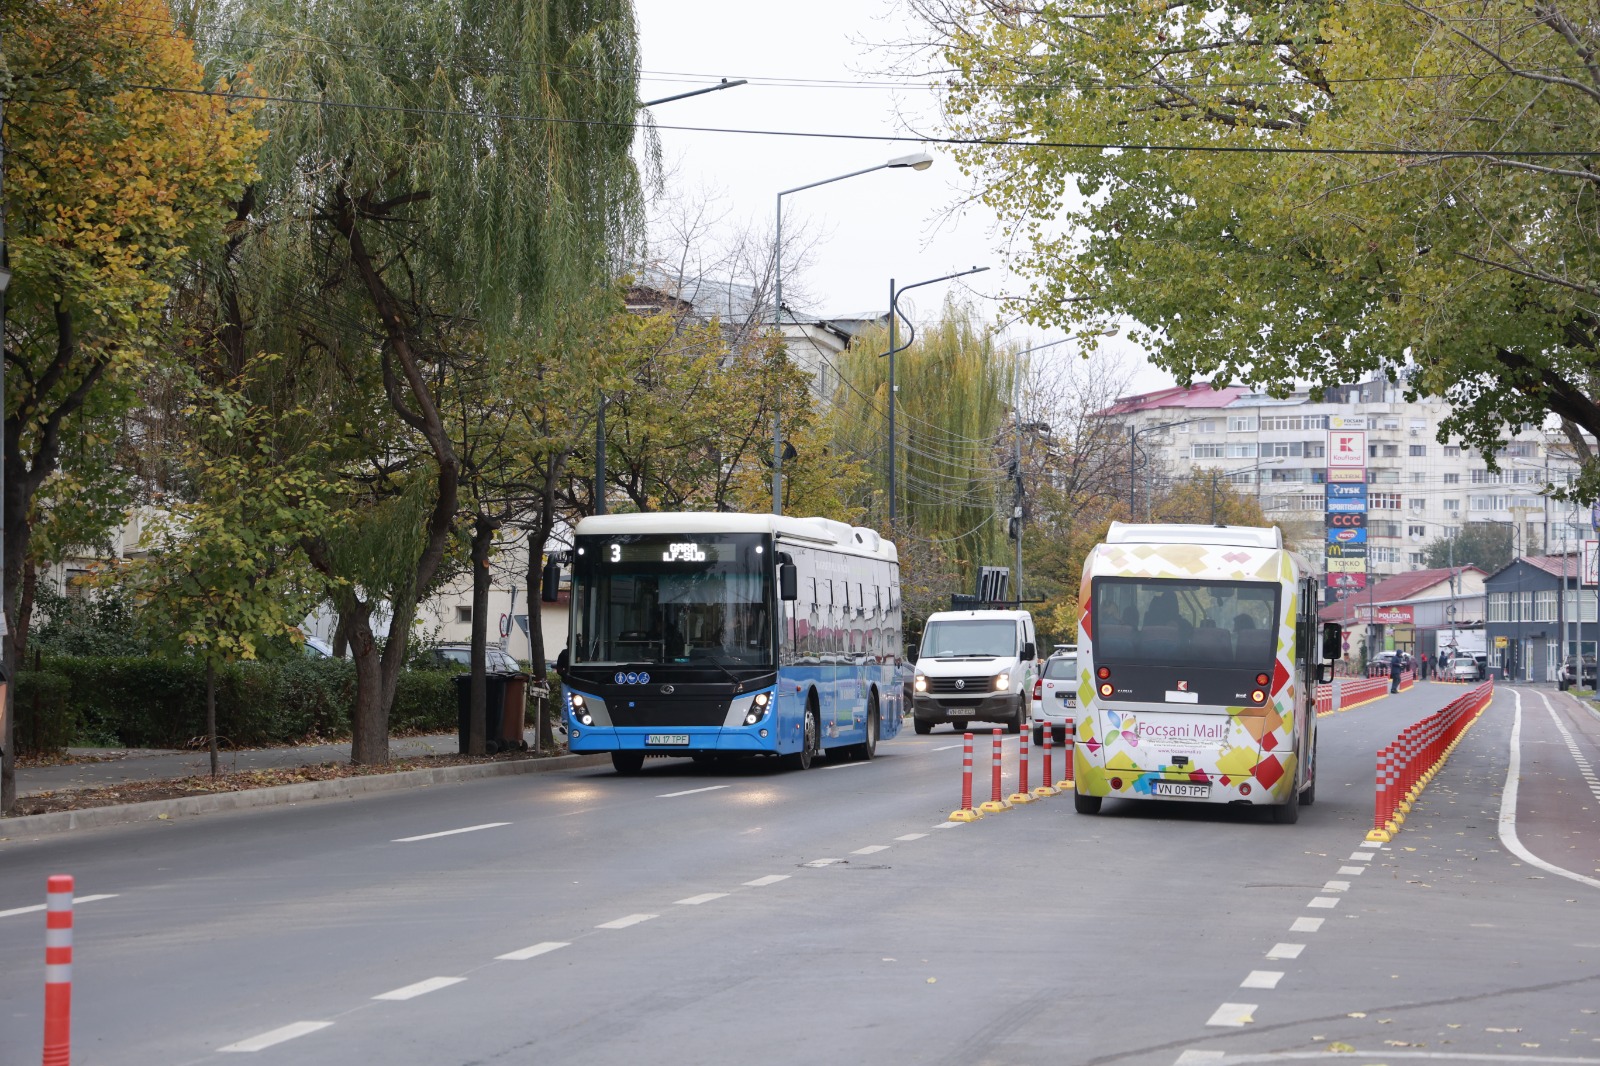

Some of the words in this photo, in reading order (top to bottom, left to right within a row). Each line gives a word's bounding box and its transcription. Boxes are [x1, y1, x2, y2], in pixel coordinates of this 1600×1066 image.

[1333, 515, 1360, 526] CCC
[611, 544, 621, 562] 3
[669, 543, 698, 553] GARA
[1193, 724, 1223, 738] Mall
[650, 735, 660, 743] VN
[663, 735, 670, 743] 17
[672, 735, 687, 743] TPF
[1158, 784, 1172, 794] VN
[1175, 785, 1187, 795] 09
[1189, 785, 1208, 796] TPF
